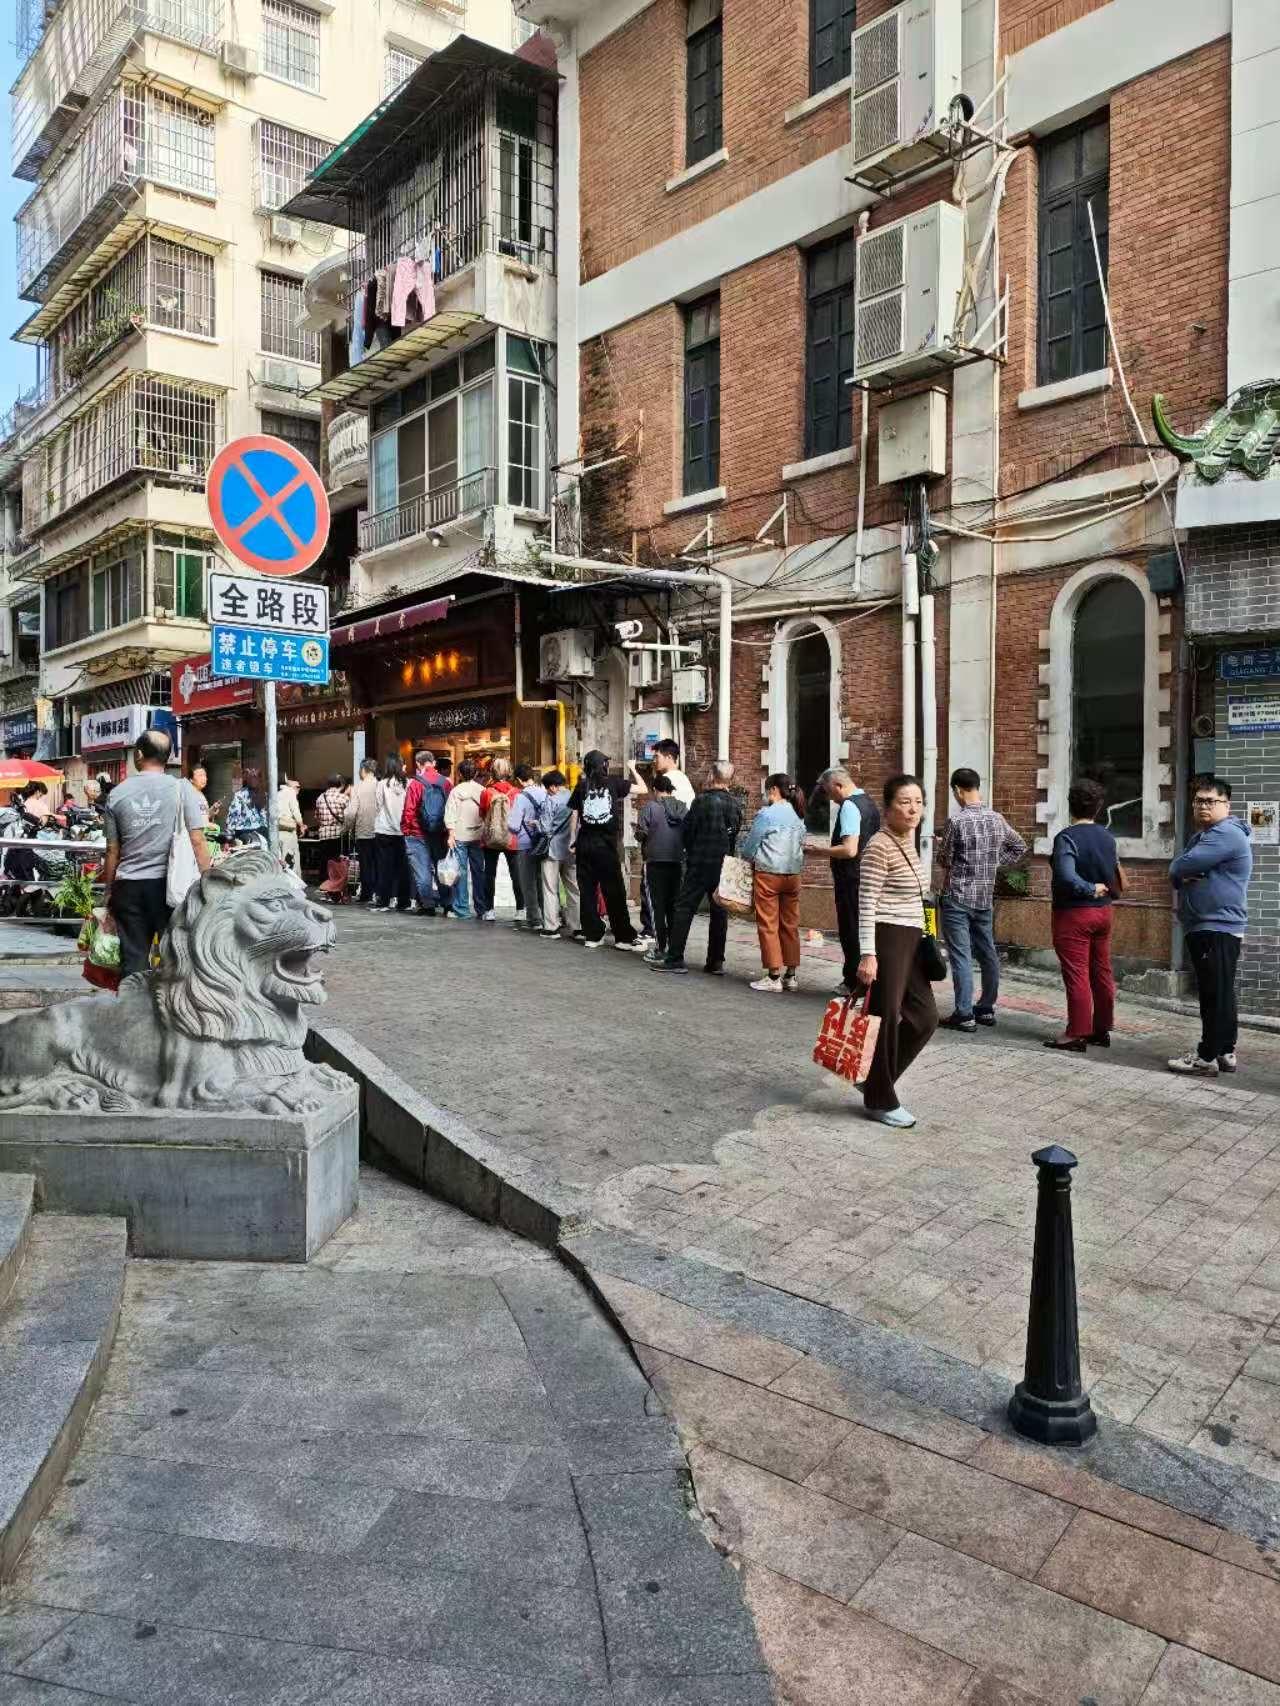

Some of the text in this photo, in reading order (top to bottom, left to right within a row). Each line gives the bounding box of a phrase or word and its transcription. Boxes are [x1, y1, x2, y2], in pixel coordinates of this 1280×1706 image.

[219, 583, 319, 626] 全路段
[218, 631, 298, 662] 禁止停车
